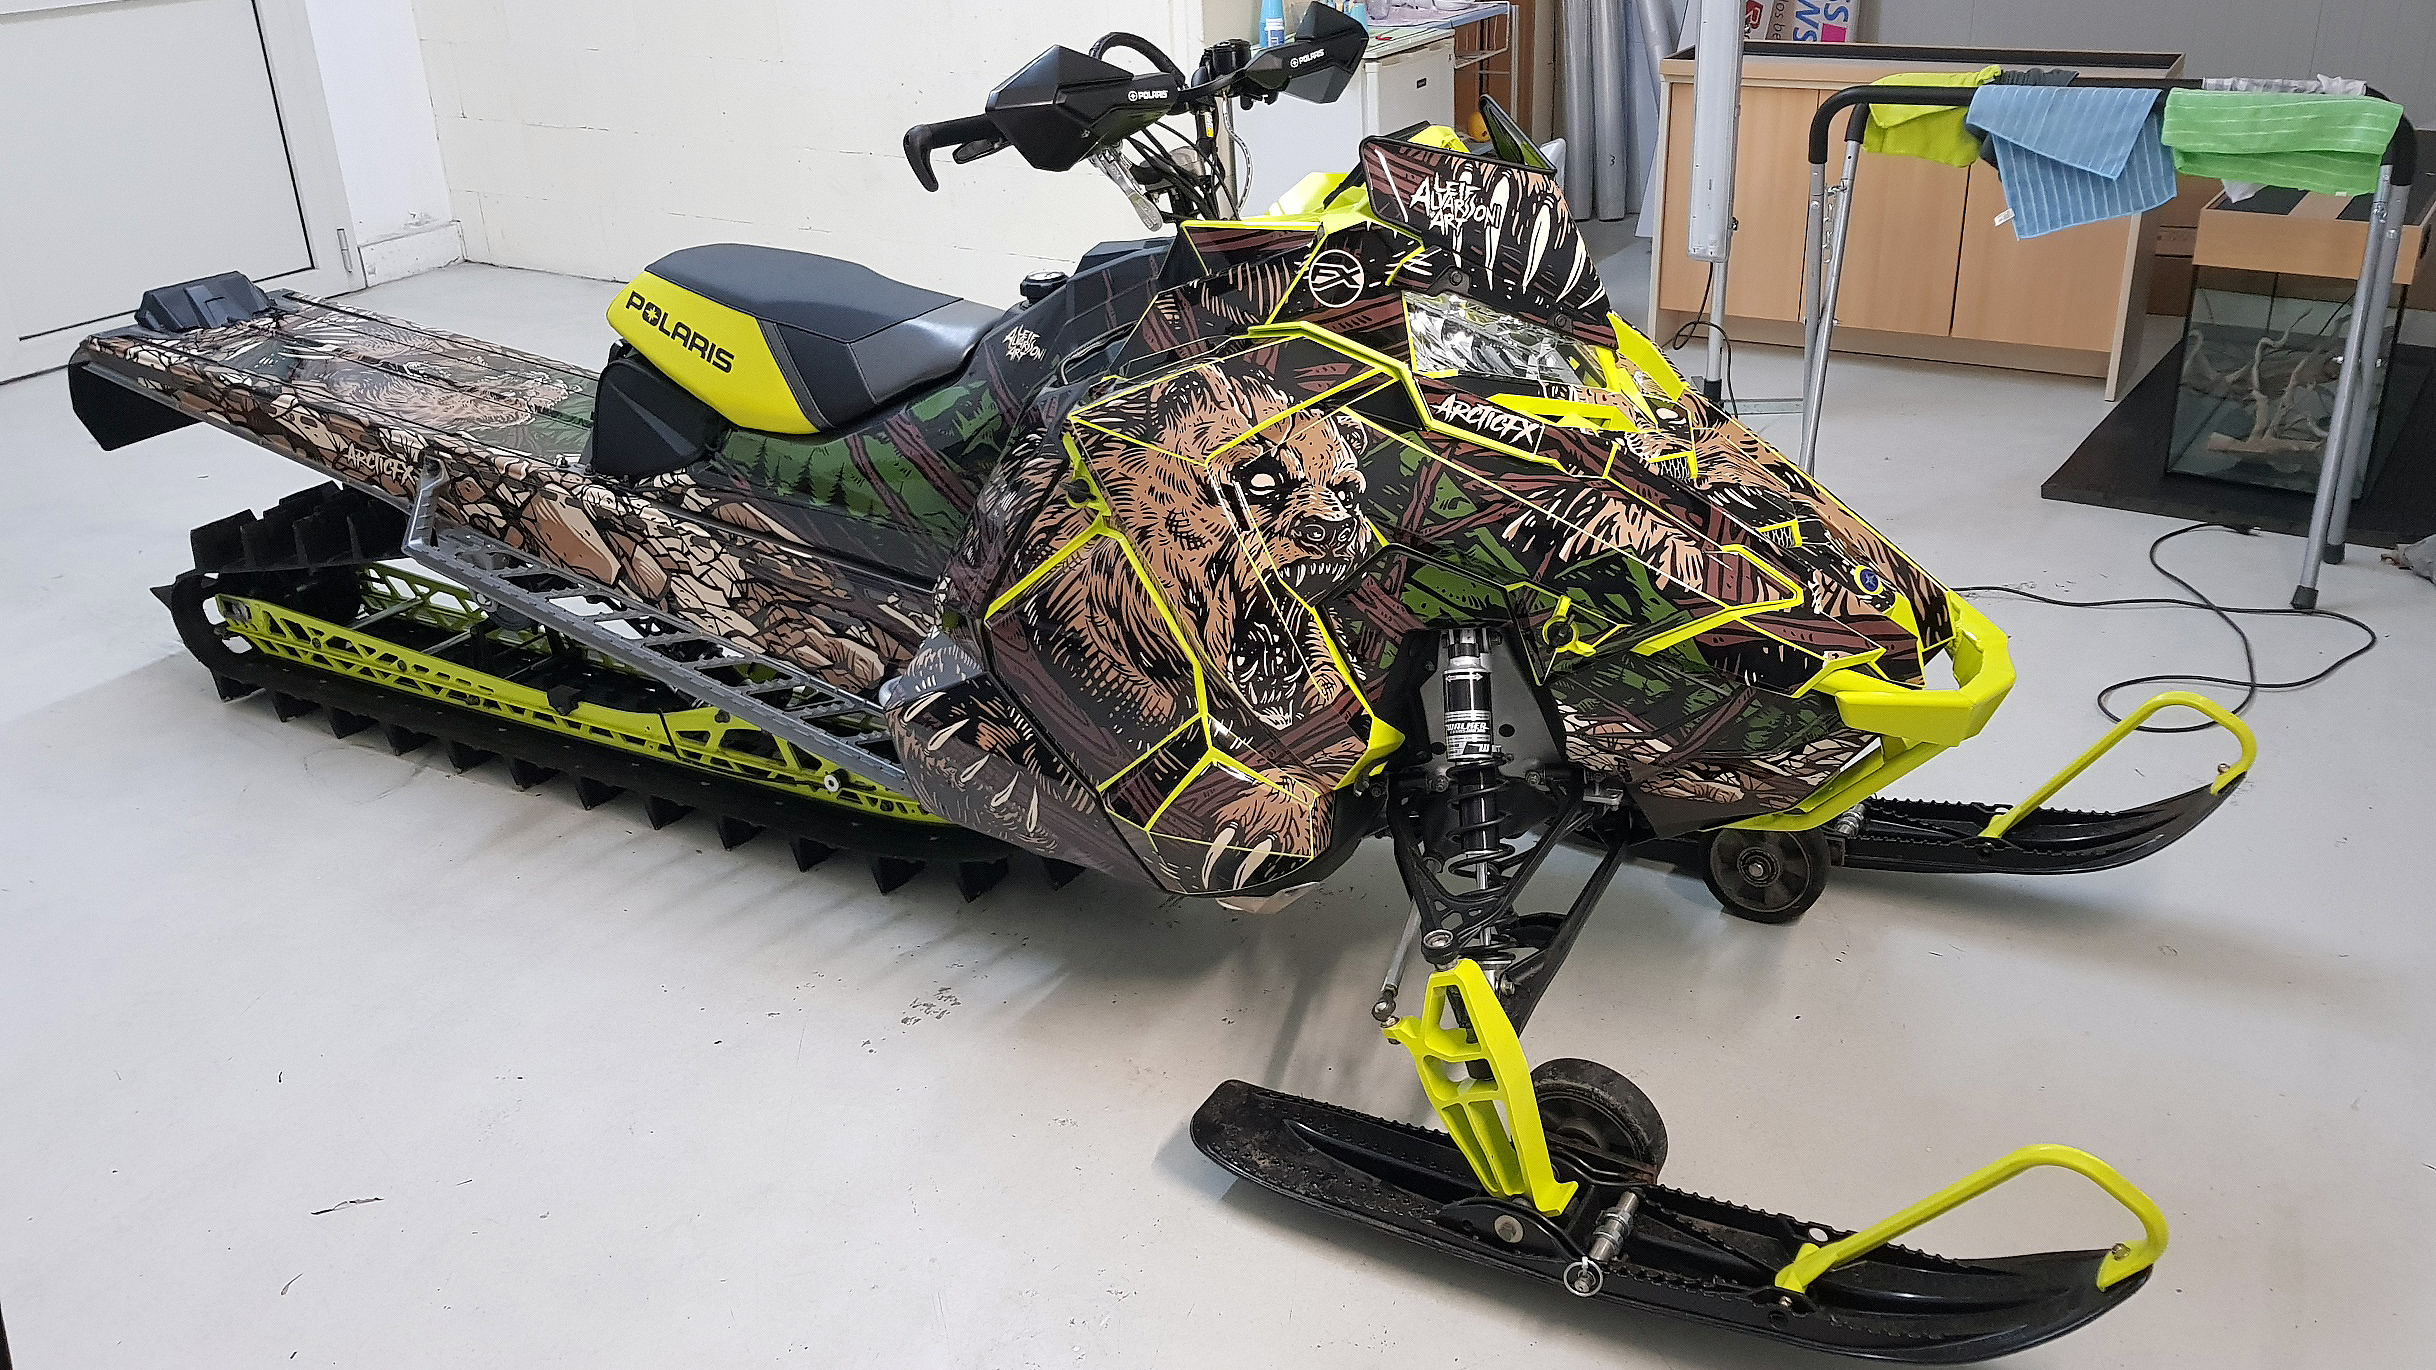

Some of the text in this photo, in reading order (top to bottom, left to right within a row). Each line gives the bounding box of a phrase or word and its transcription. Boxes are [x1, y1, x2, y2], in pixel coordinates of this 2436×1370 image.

[1299, 48, 1325, 65] POLARIS
[1138, 90, 1169, 100] POLARIS
[625, 290, 735, 374] POLARIS
